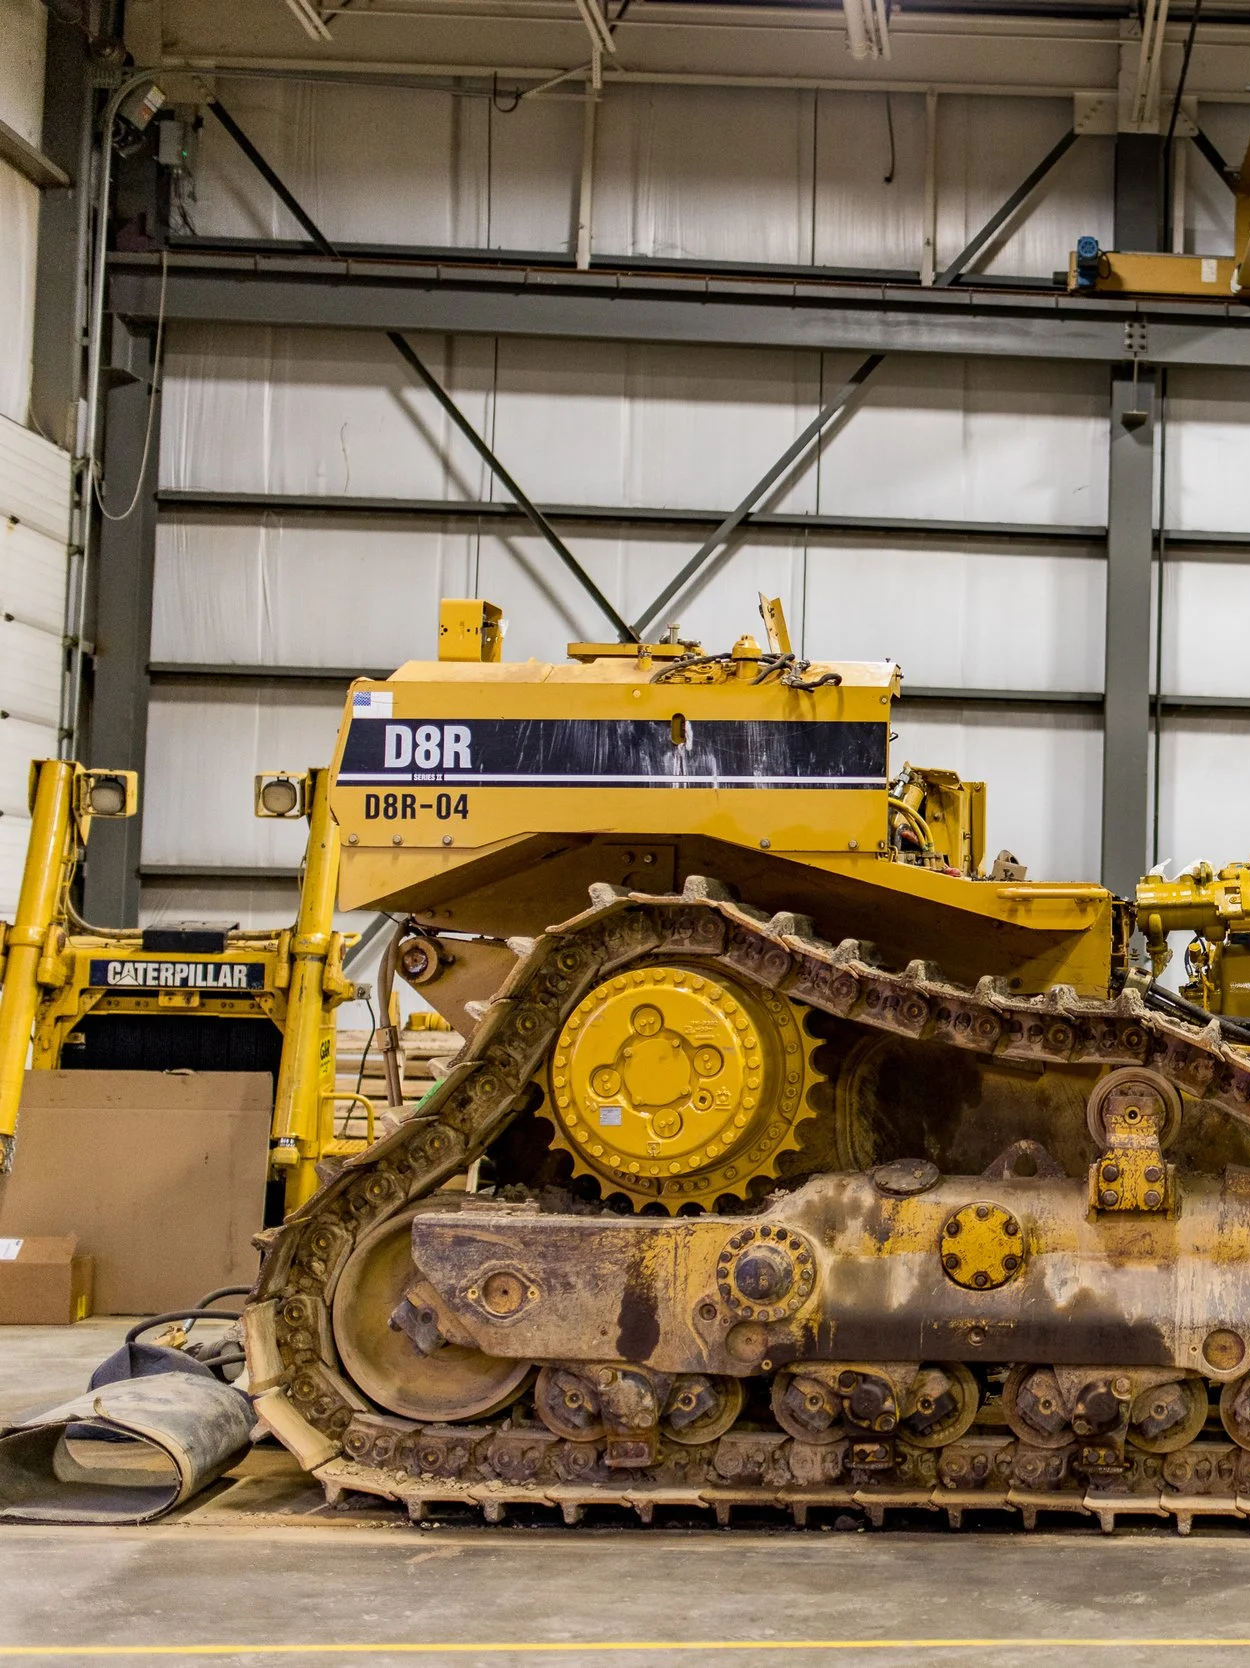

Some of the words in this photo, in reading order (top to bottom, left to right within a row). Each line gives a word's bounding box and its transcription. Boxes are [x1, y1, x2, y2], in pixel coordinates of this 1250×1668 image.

[384, 724, 473, 770] D8R
[413, 773, 436, 781] SERIES
[364, 792, 470, 821] D8R-04
[107, 961, 248, 989] CATERPILLAR
